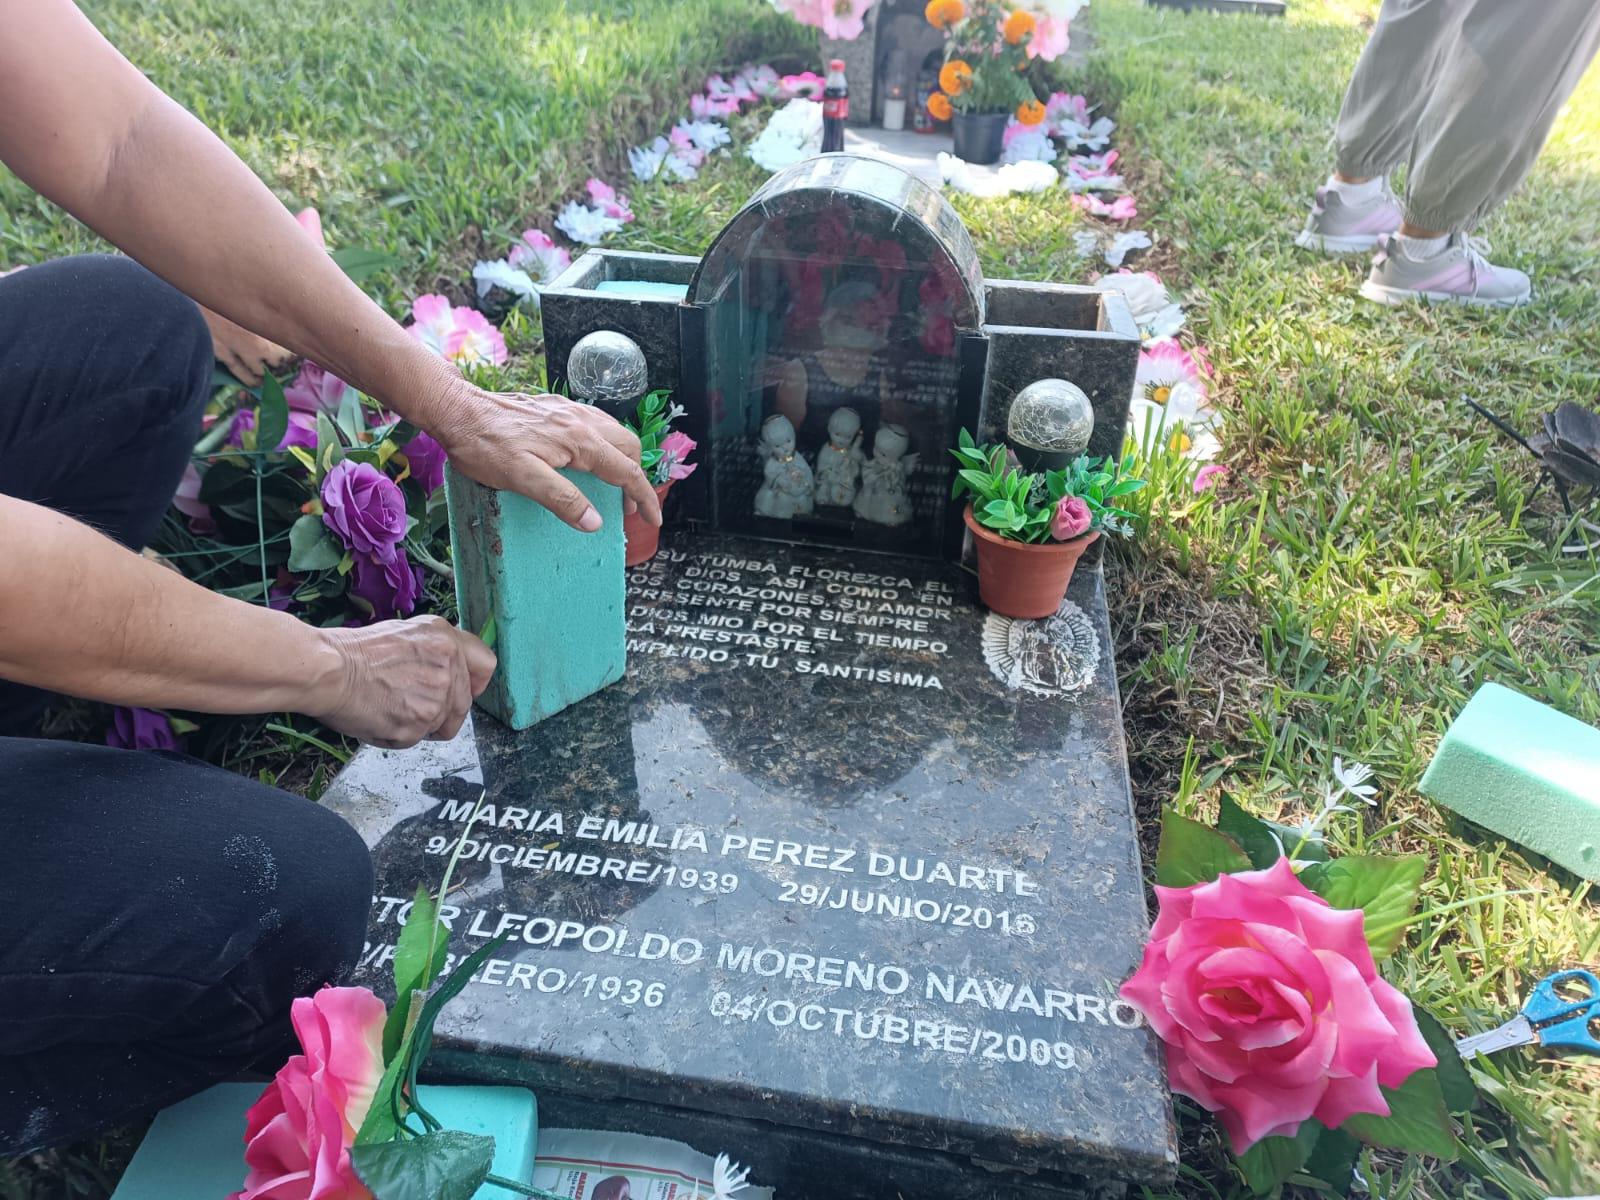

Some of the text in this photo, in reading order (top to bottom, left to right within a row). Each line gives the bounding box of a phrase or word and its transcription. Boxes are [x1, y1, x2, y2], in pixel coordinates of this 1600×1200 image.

[625, 573, 664, 587] OS
[838, 598, 871, 613] SU
[877, 602, 952, 621] AMOR
[685, 566, 741, 582] DIOS
[766, 576, 806, 590] ASI
[826, 583, 899, 600] COMO
[919, 592, 953, 606] EN
[699, 555, 777, 574] TUMBA
[788, 565, 914, 589] FLOREZCA
[924, 580, 955, 594] EL
[627, 586, 755, 612] PRESENTE
[760, 602, 813, 619] POR
[625, 619, 817, 655] LA PRESTASTE.
[630, 605, 949, 655] DIOS MIO POR EL TIEMPO
[626, 638, 944, 690] MPLIDO TU SANTISIMA
[437, 798, 1040, 898] MARIA EMILIA PEREZ DUARTE
[424, 835, 1037, 936] 9/DICIEMBRE/1939 29/JUNIO/2016
[372, 895, 1144, 1030] TR LEOPOLDO MORENO NAVARRO
[356, 941, 1078, 1071] /FERO/1936 04/OCTUBRE/2009
